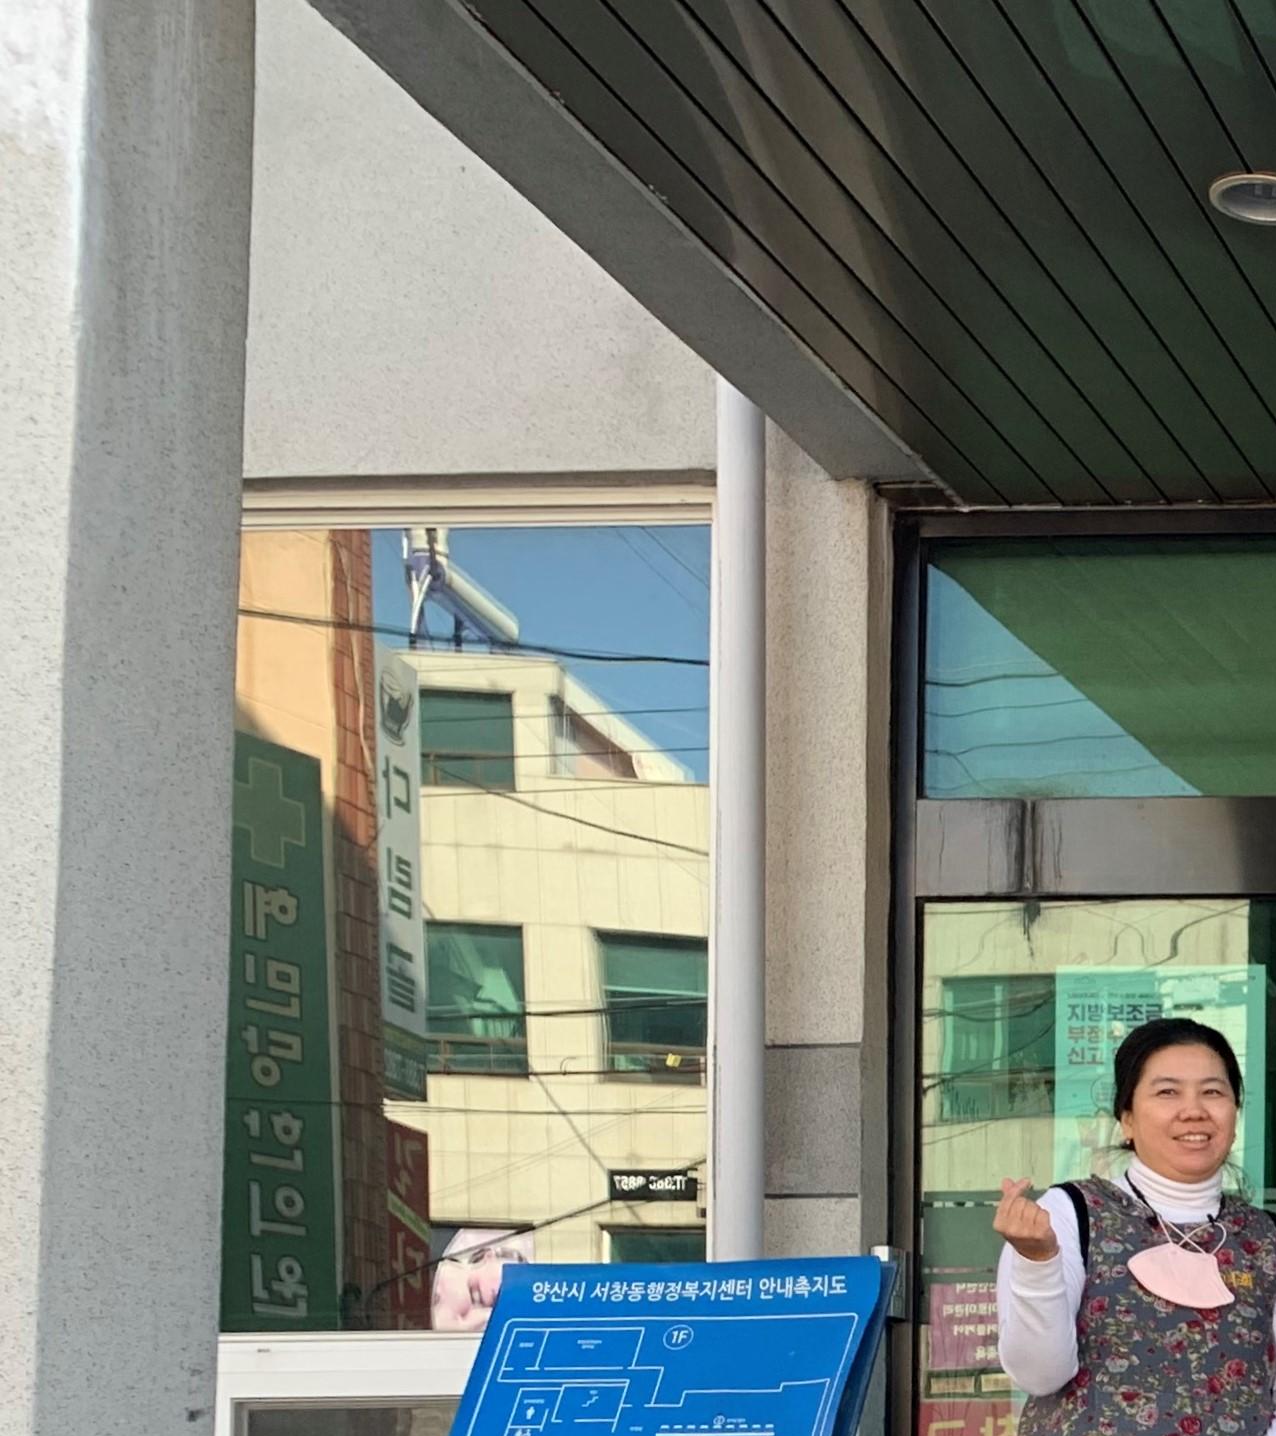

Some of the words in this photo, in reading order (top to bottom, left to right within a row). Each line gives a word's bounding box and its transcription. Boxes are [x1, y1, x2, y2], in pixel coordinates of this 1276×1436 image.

[531, 1280, 586, 1302] 양산시
[590, 1277, 754, 1302] 서창동행정복지센터
[758, 1274, 848, 1299] 안내촉지도
[669, 1328, 690, 1345] 1F
